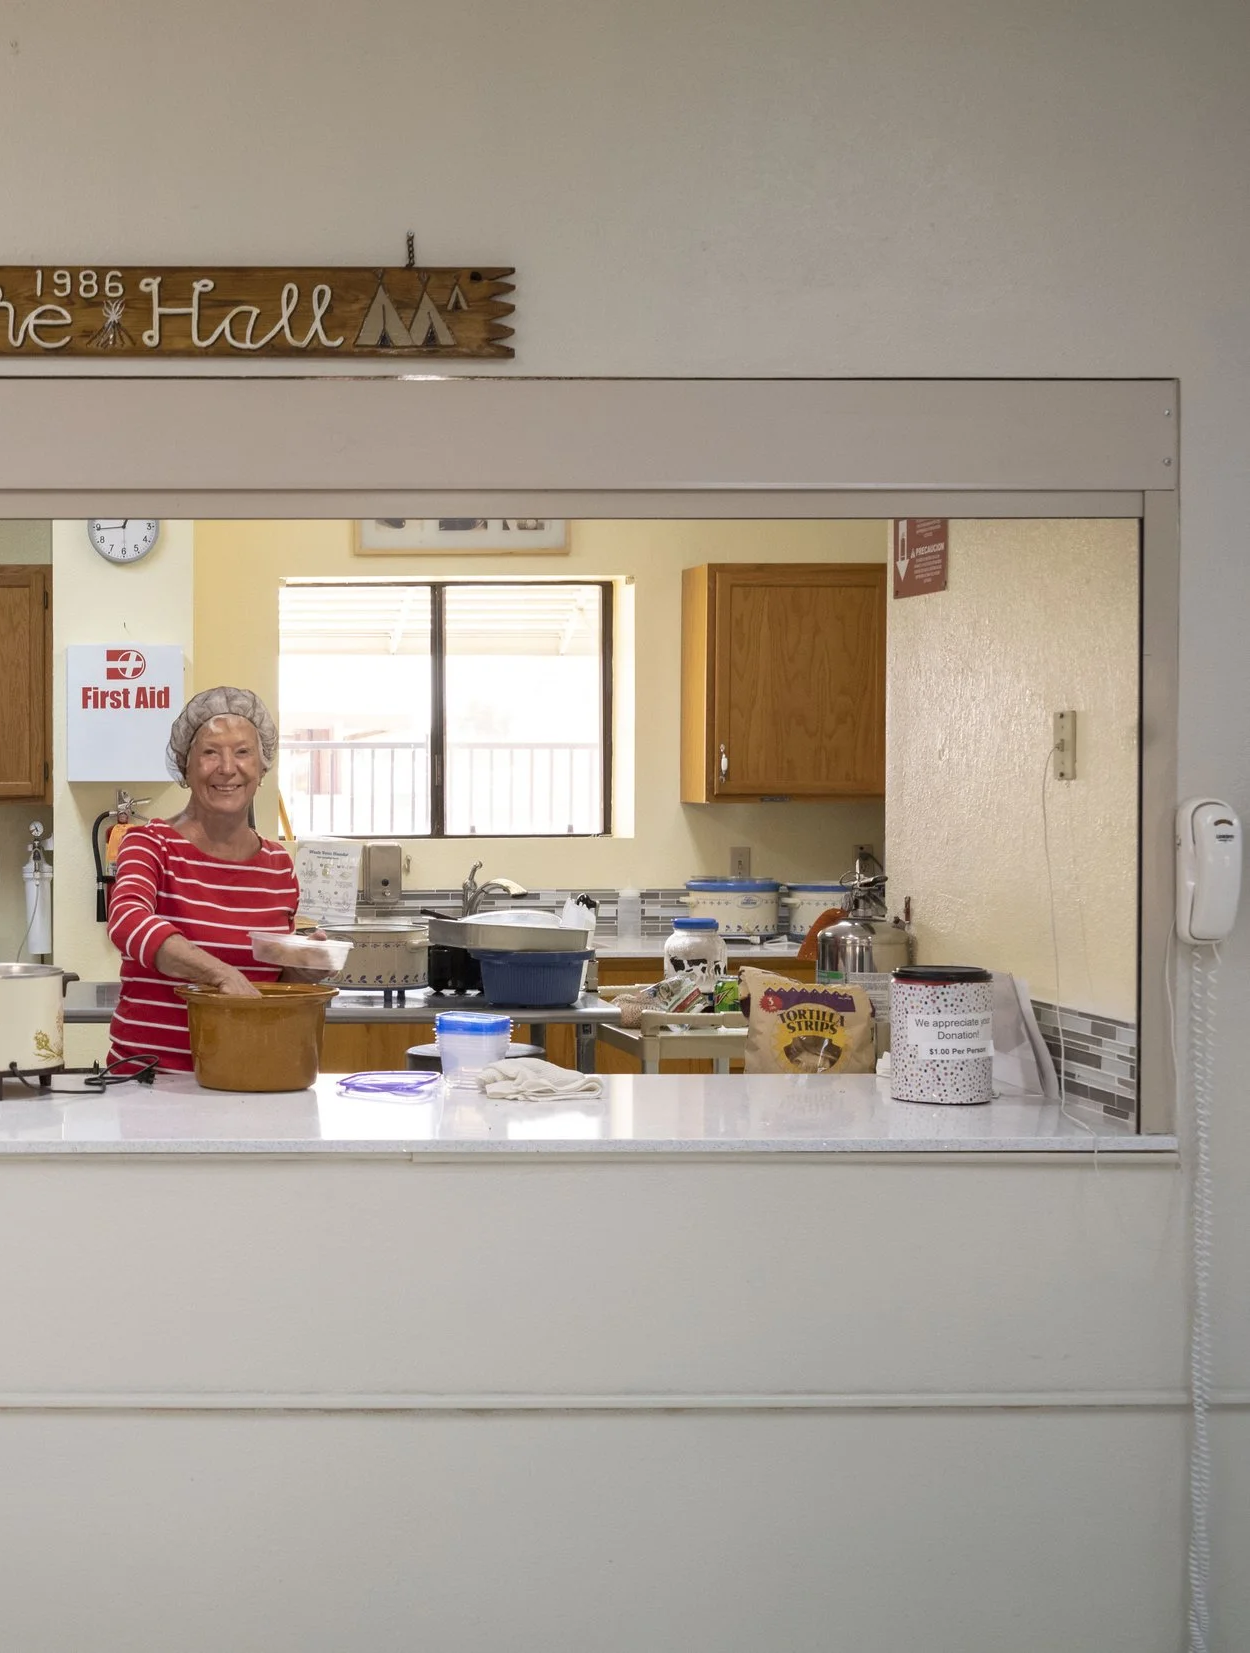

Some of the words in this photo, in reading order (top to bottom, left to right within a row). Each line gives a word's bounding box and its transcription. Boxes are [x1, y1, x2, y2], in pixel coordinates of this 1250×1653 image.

[34, 269, 125, 299] 1986
[138, 276, 344, 350] Hall
[146, 522, 152, 530] 3
[109, 544, 115, 552] 7
[121, 547, 127, 555] 6
[133, 544, 139, 552] 5
[81, 686, 131, 709] First
[134, 686, 170, 709] Aid
[777, 1009, 845, 1026] TORTILLA
[786, 1020, 838, 1035] STRIPS
[915, 1018, 930, 1027] We
[932, 1018, 979, 1028] appreciate
[937, 1030, 980, 1040] Donation!
[929, 1047, 950, 1055] $1.00
[952, 1047, 965, 1055] Per
[966, 1047, 986, 1055] Person
